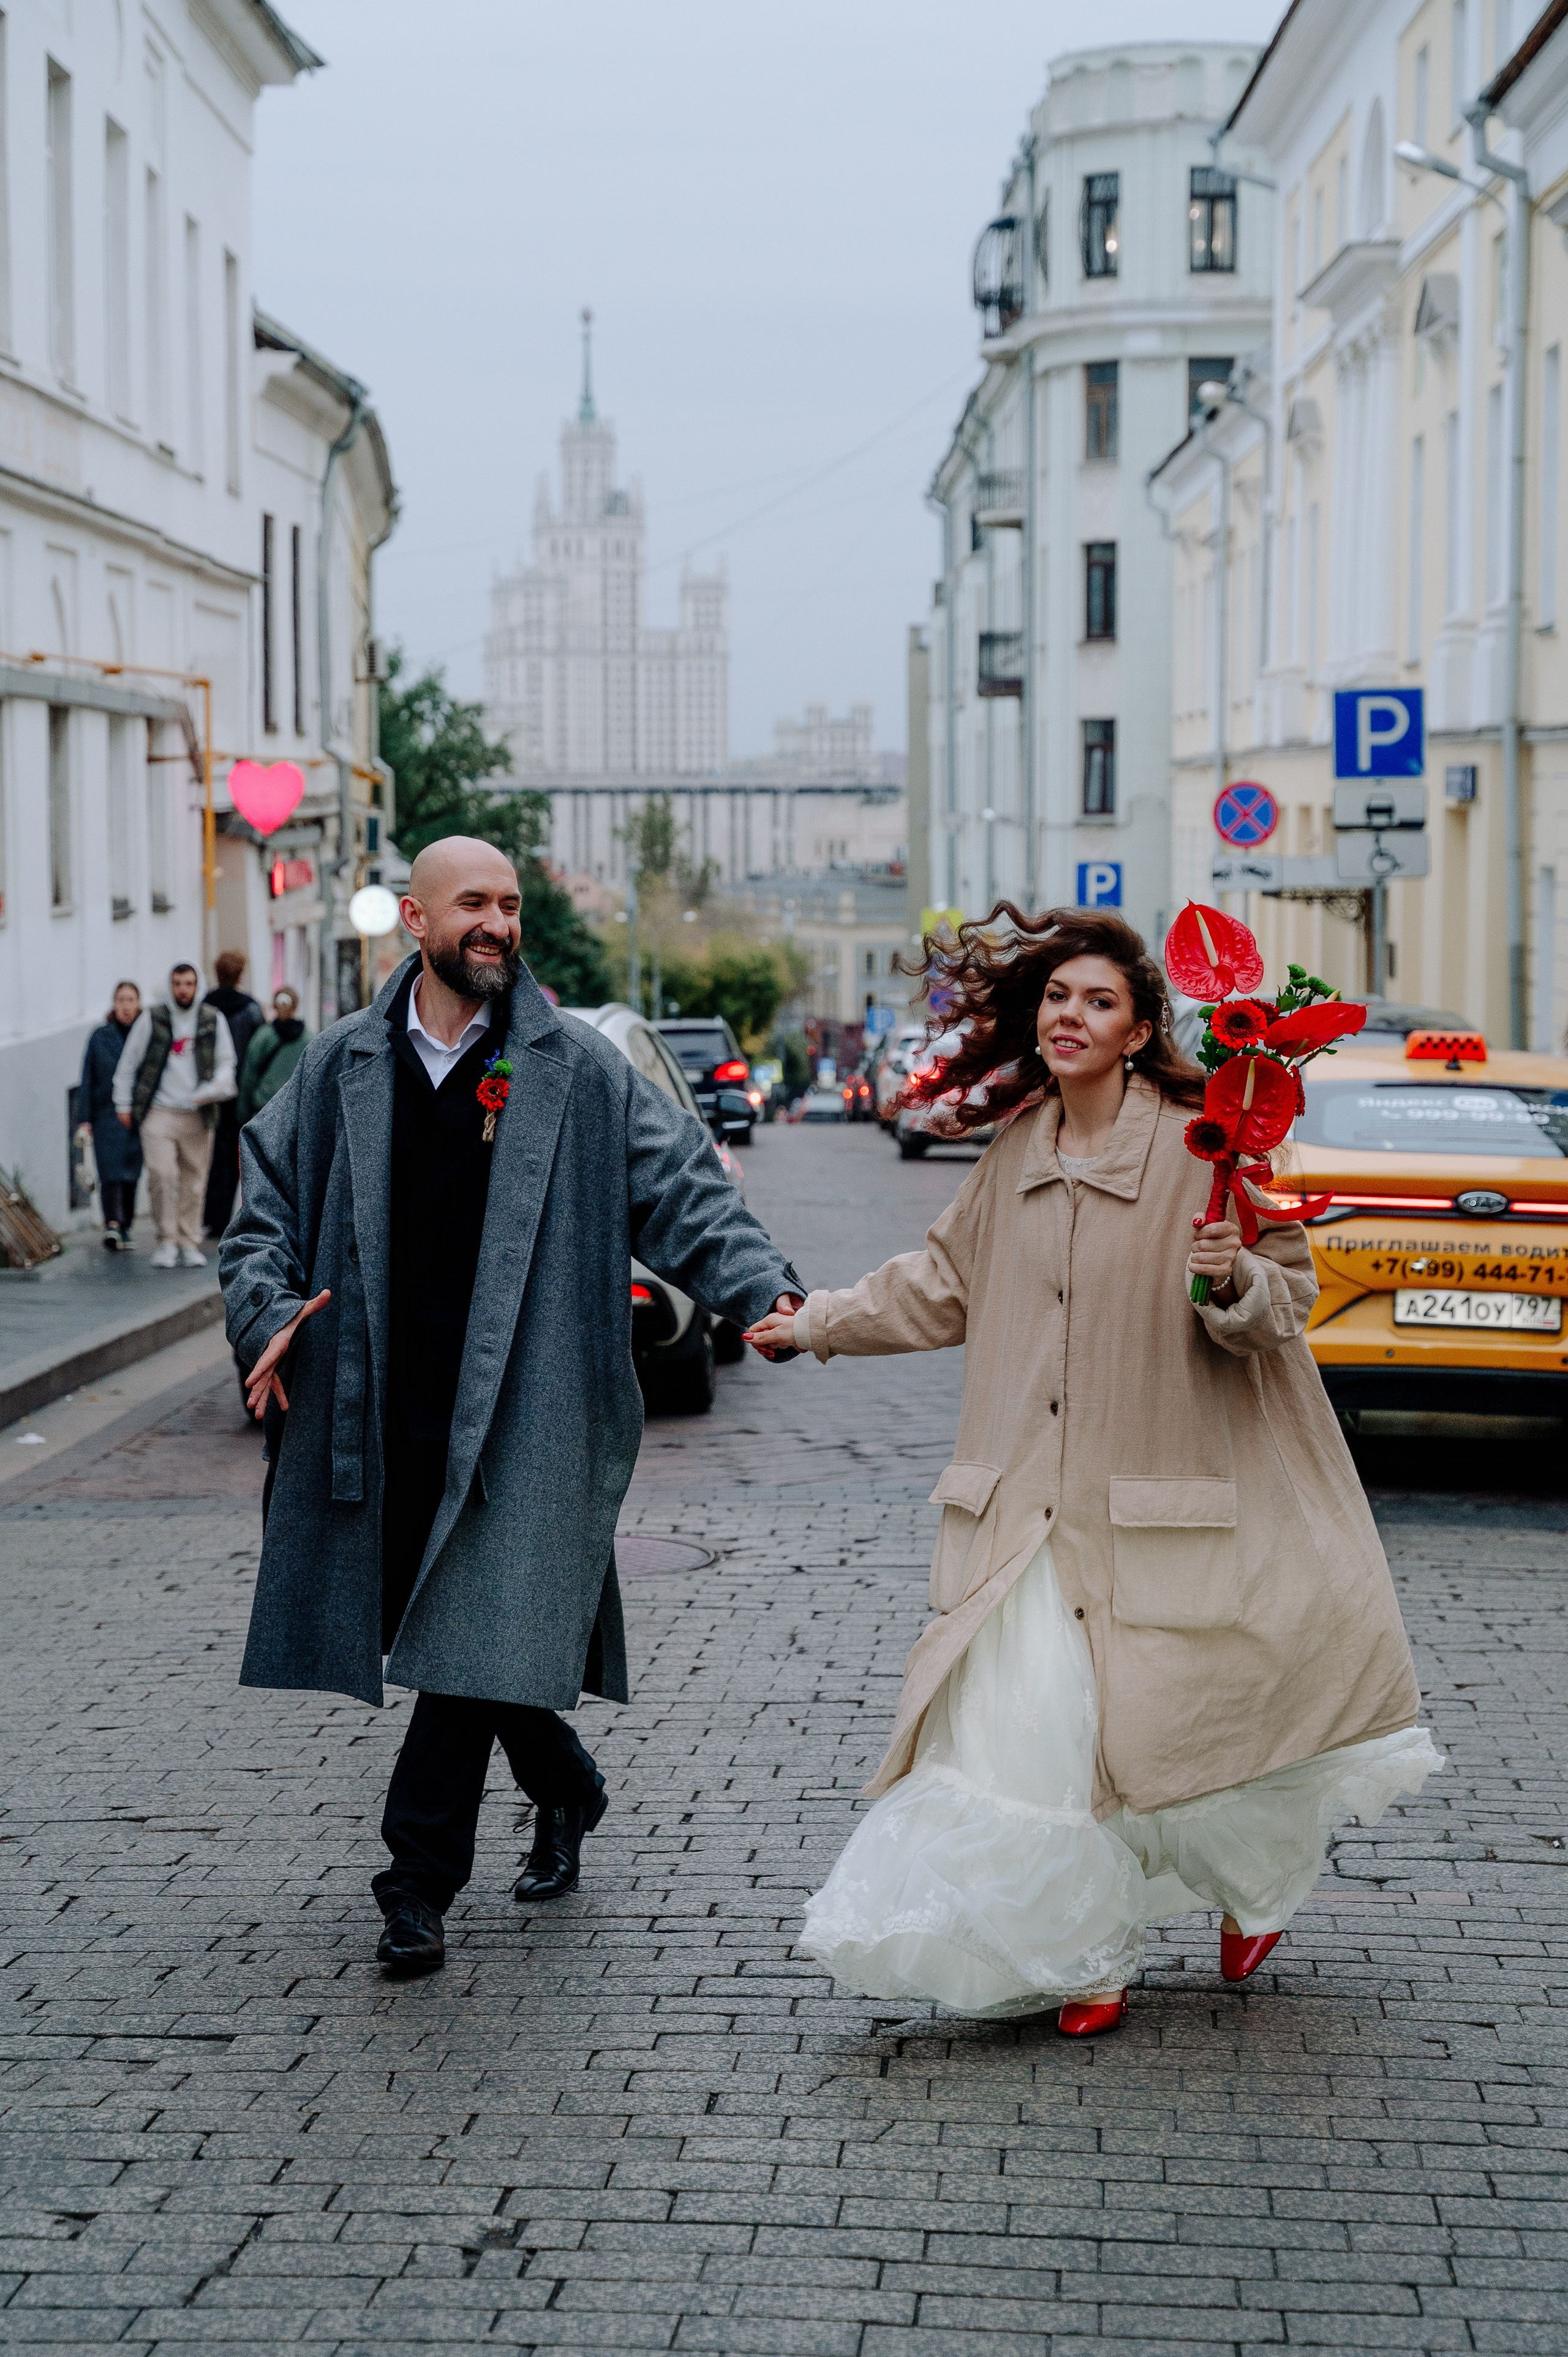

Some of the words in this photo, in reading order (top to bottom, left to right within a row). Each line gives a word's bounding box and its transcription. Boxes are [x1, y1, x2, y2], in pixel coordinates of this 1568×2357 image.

[1357, 696, 1410, 772] P
[1087, 865, 1117, 905] P
[1327, 1235, 1491, 1254] Приглашаем
[1474, 1263, 1568, 1284] 444-71-
